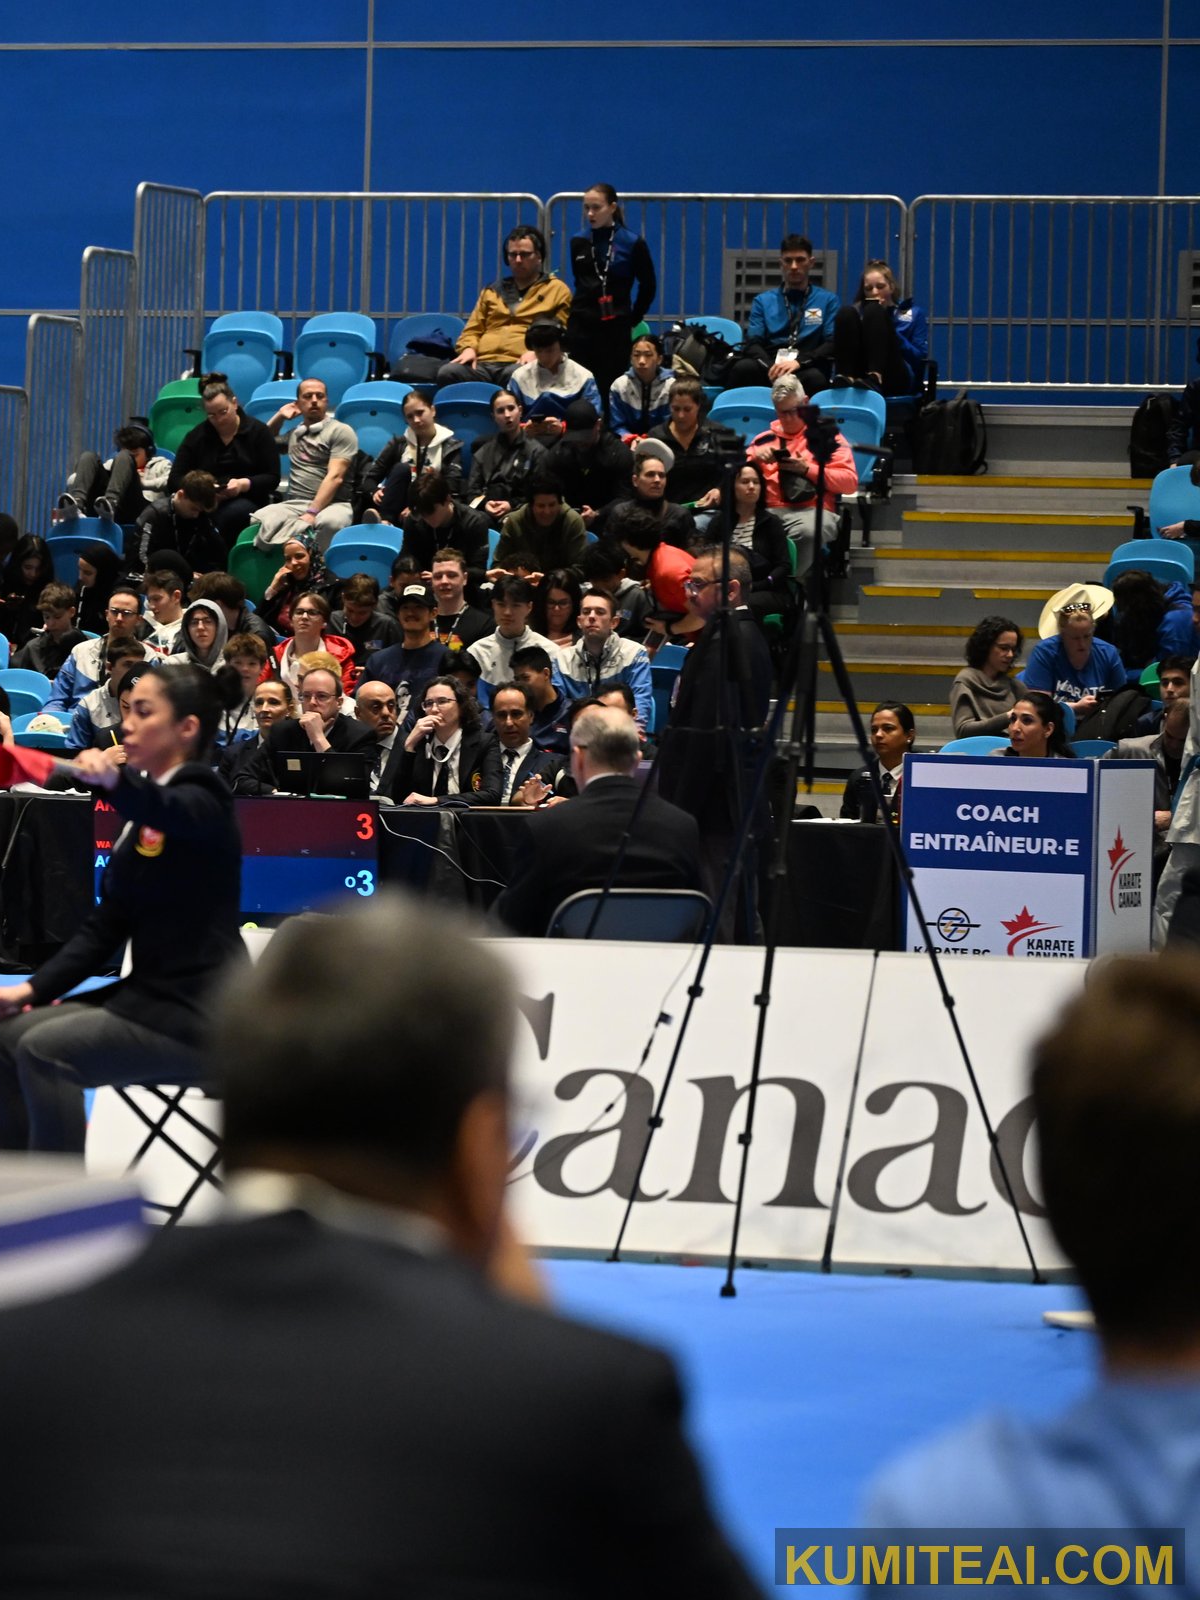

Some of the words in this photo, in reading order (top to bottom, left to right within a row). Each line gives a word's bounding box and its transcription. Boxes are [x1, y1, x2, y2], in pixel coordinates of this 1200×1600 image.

[956, 803, 1040, 823] COACH
[356, 813, 374, 840] 3
[909, 831, 1080, 856] ENTRAÎNEUR·E
[1026, 938, 1075, 952] KARATE
